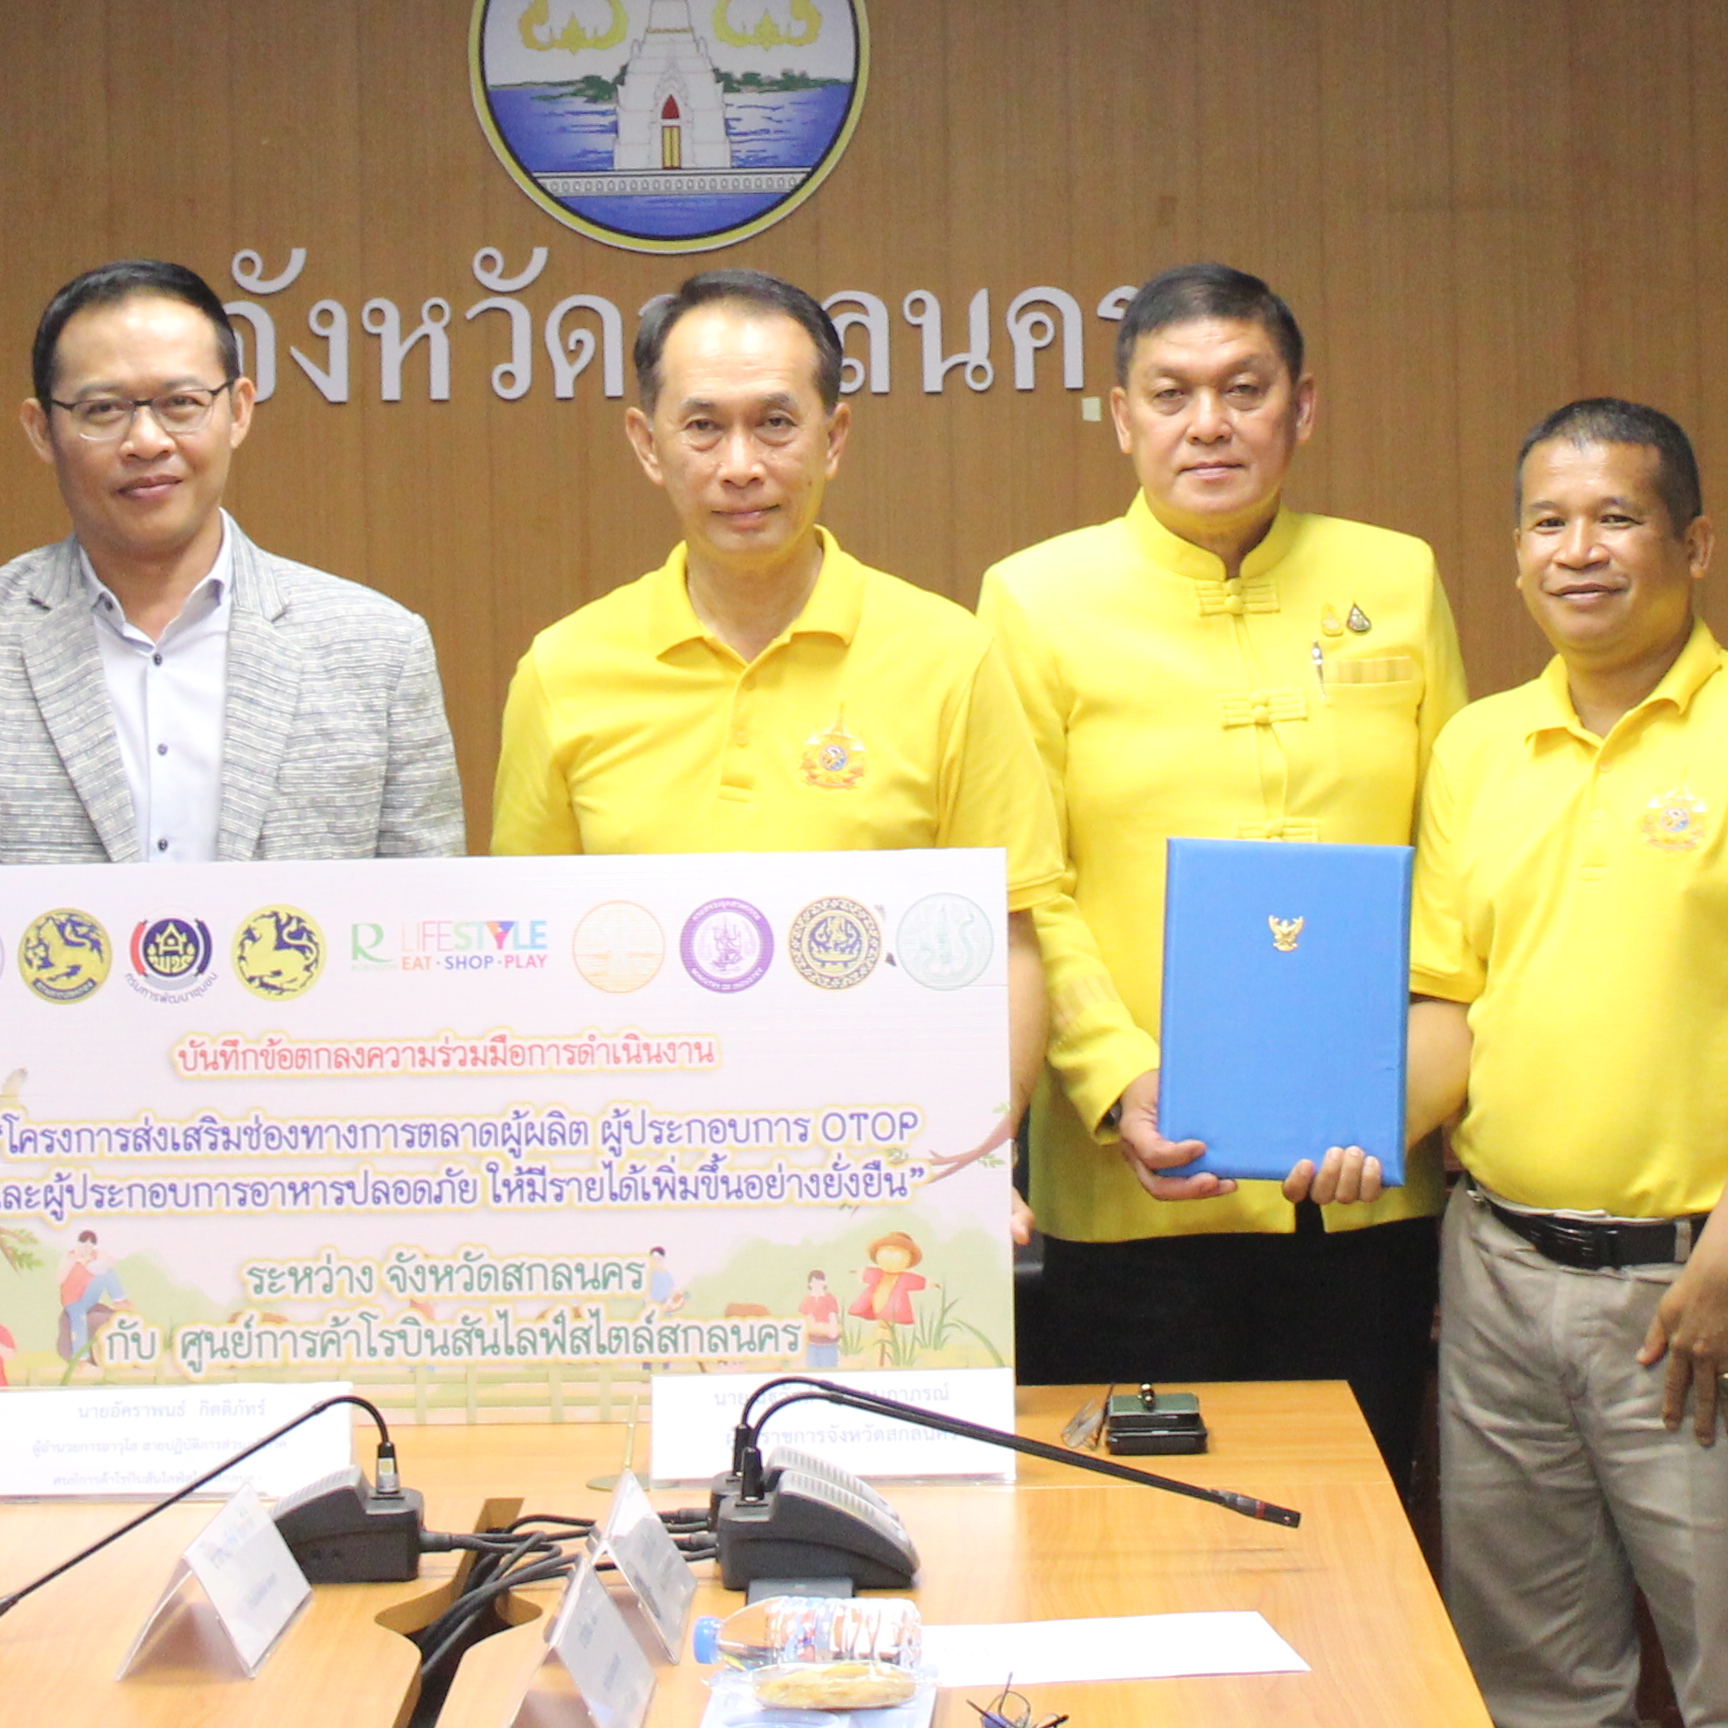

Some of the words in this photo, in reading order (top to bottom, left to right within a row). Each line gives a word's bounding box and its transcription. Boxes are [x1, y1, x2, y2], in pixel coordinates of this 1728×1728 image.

[401, 920, 548, 952] LIFESTYLE
[401, 955, 432, 970] EAT
[445, 955, 494, 970] SHOP
[504, 954, 548, 969] PLAY
[177, 1033, 715, 1072] บันทึกข้อตกลงความร่วมมือการดำเนินงาน
[601, 1108, 810, 1157] ผู้ประกอบการ
[821, 1112, 919, 1143] OTOP
[247, 1254, 373, 1294] ระหว่าง
[387, 1250, 645, 1293] จังหวัดสกลนคร
[106, 1319, 156, 1360] กับ
[180, 1308, 802, 1373] ศูนย์การค้าโรบินสันไลฟ์สไตล์สกลนคร
